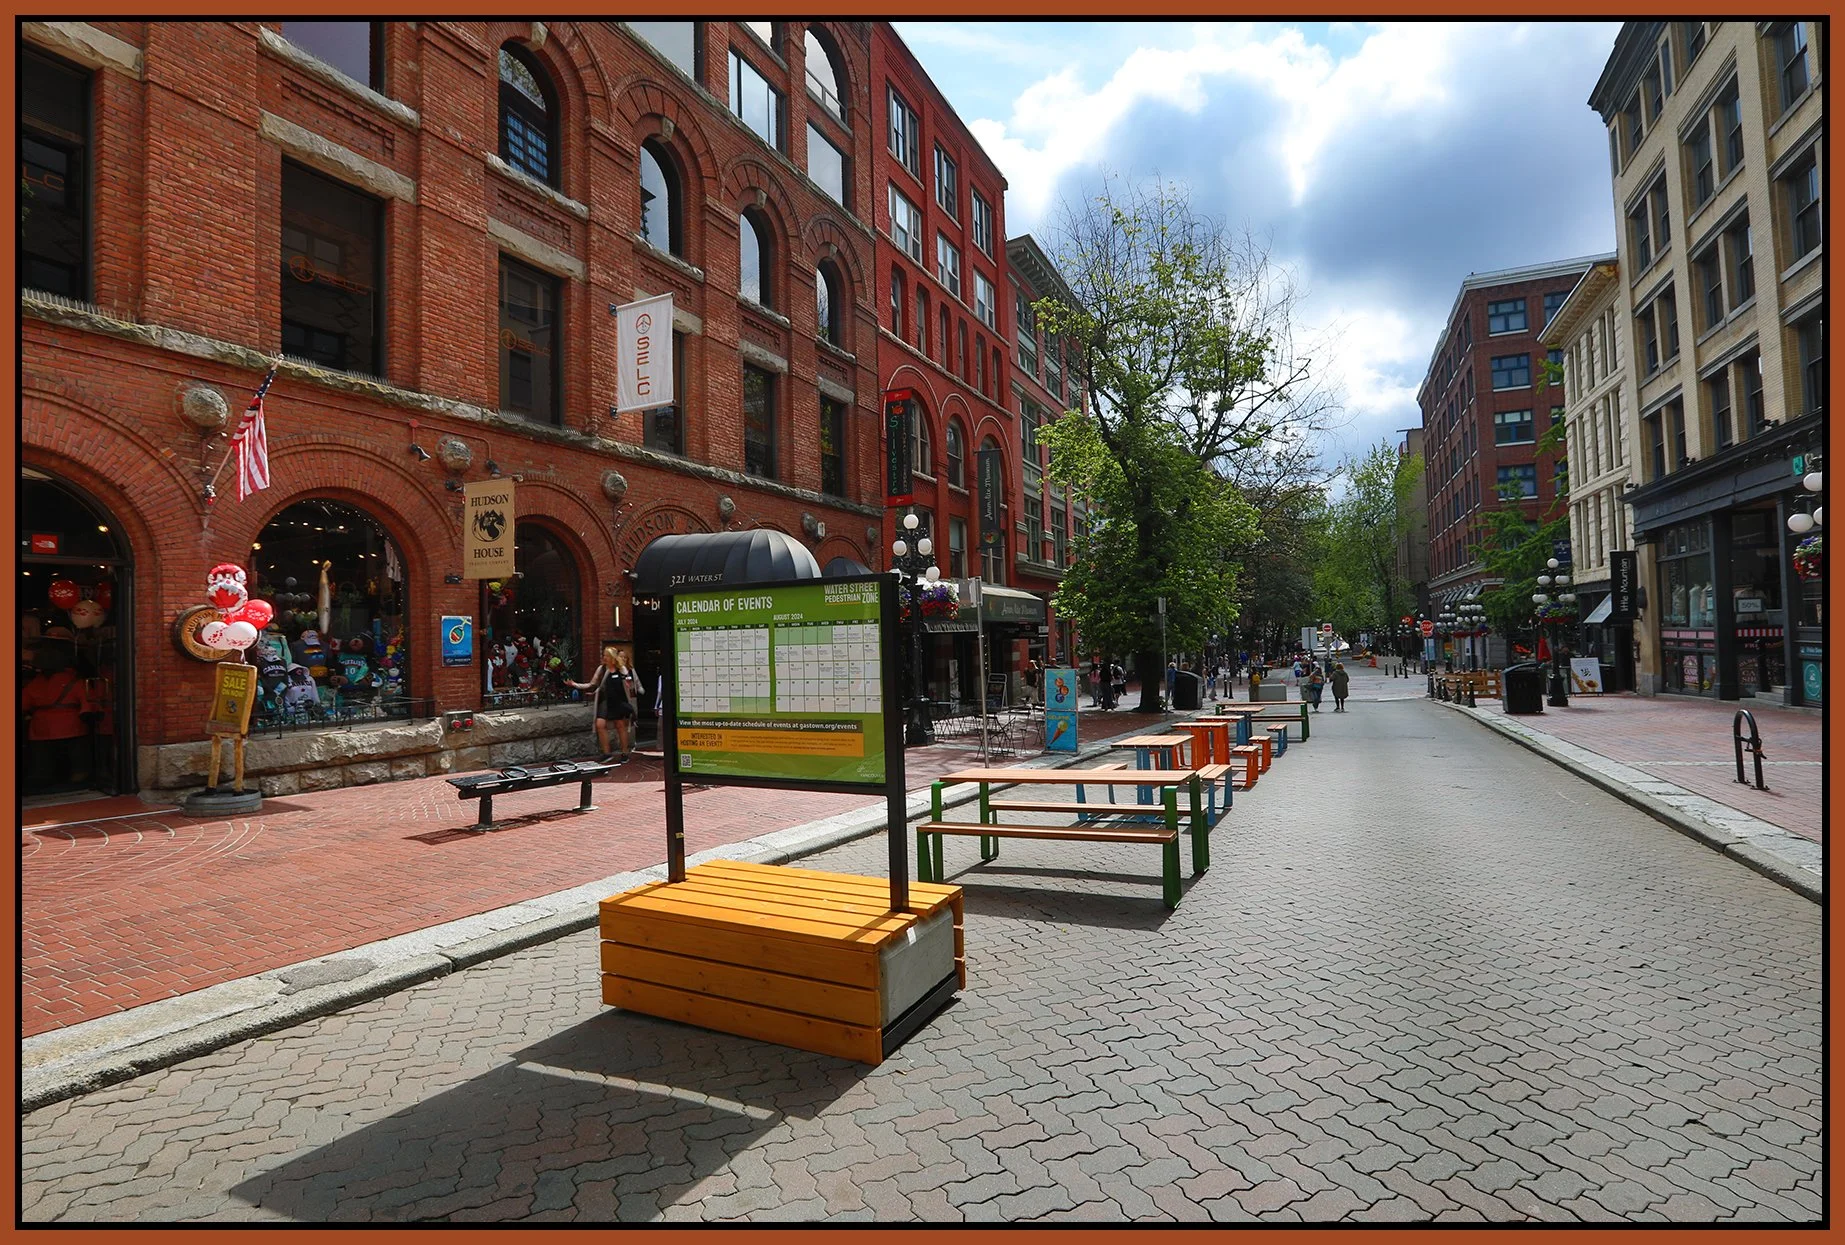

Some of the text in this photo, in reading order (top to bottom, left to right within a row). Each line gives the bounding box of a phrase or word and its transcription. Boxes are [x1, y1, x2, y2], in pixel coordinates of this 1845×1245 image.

[637, 336, 650, 396] SELC
[470, 493, 509, 507] HUDSON
[620, 512, 677, 568] HUDSON
[473, 547, 505, 559] HOUSE
[669, 575, 686, 587] 321
[1620, 558, 1629, 612] little Mountain
[824, 582, 878, 594] WATER STREET
[825, 592, 878, 603] PEDESTRIAN ZONE
[676, 596, 773, 614] CALENDAR OF EVENTS
[1741, 601, 1760, 609] 50%
[773, 613, 790, 621] AUGUST
[344, 667, 356, 675] 10
[223, 676, 247, 690] SALE
[222, 688, 230, 696] ON
[799, 722, 857, 731] gastown.org/events
